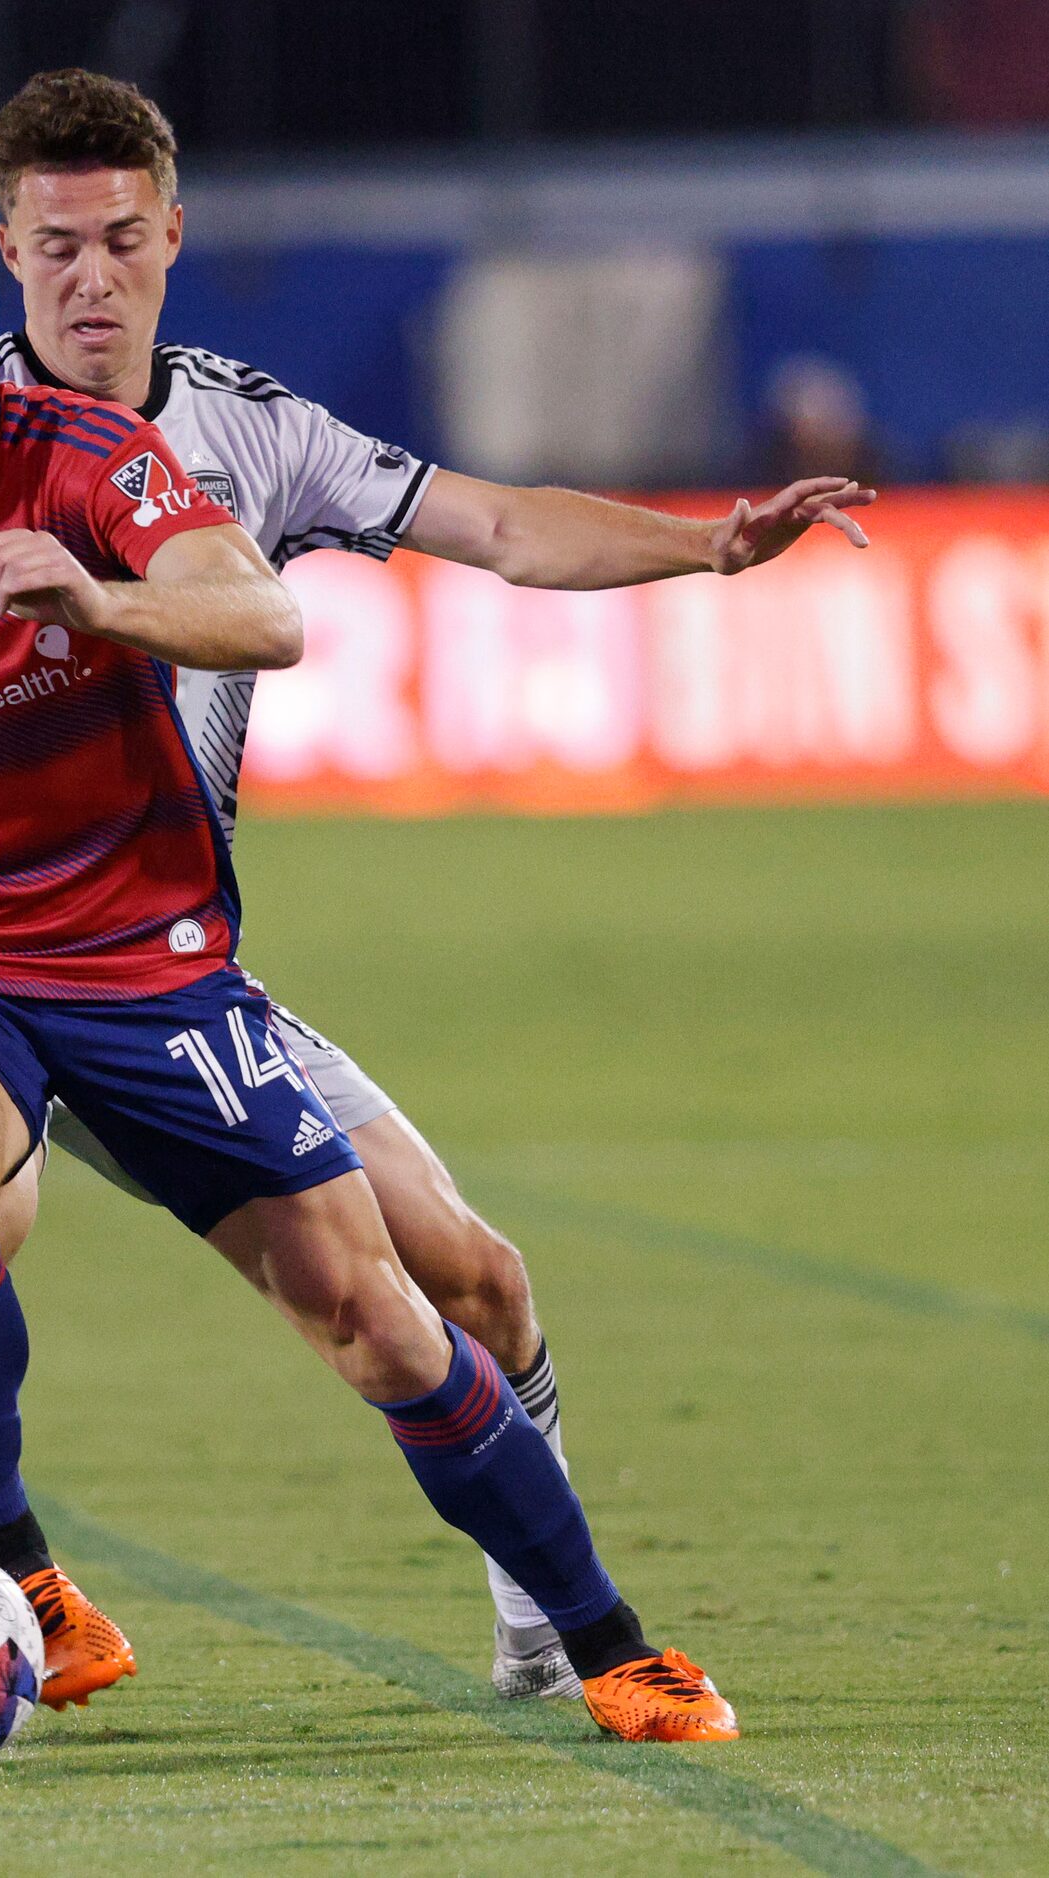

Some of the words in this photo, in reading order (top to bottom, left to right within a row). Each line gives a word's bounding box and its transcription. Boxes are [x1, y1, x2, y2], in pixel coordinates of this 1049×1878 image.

[116, 462, 144, 485] MLS
[176, 929, 197, 948] LH
[165, 1006, 305, 1128] 14
[292, 1126, 335, 1157] adidas
